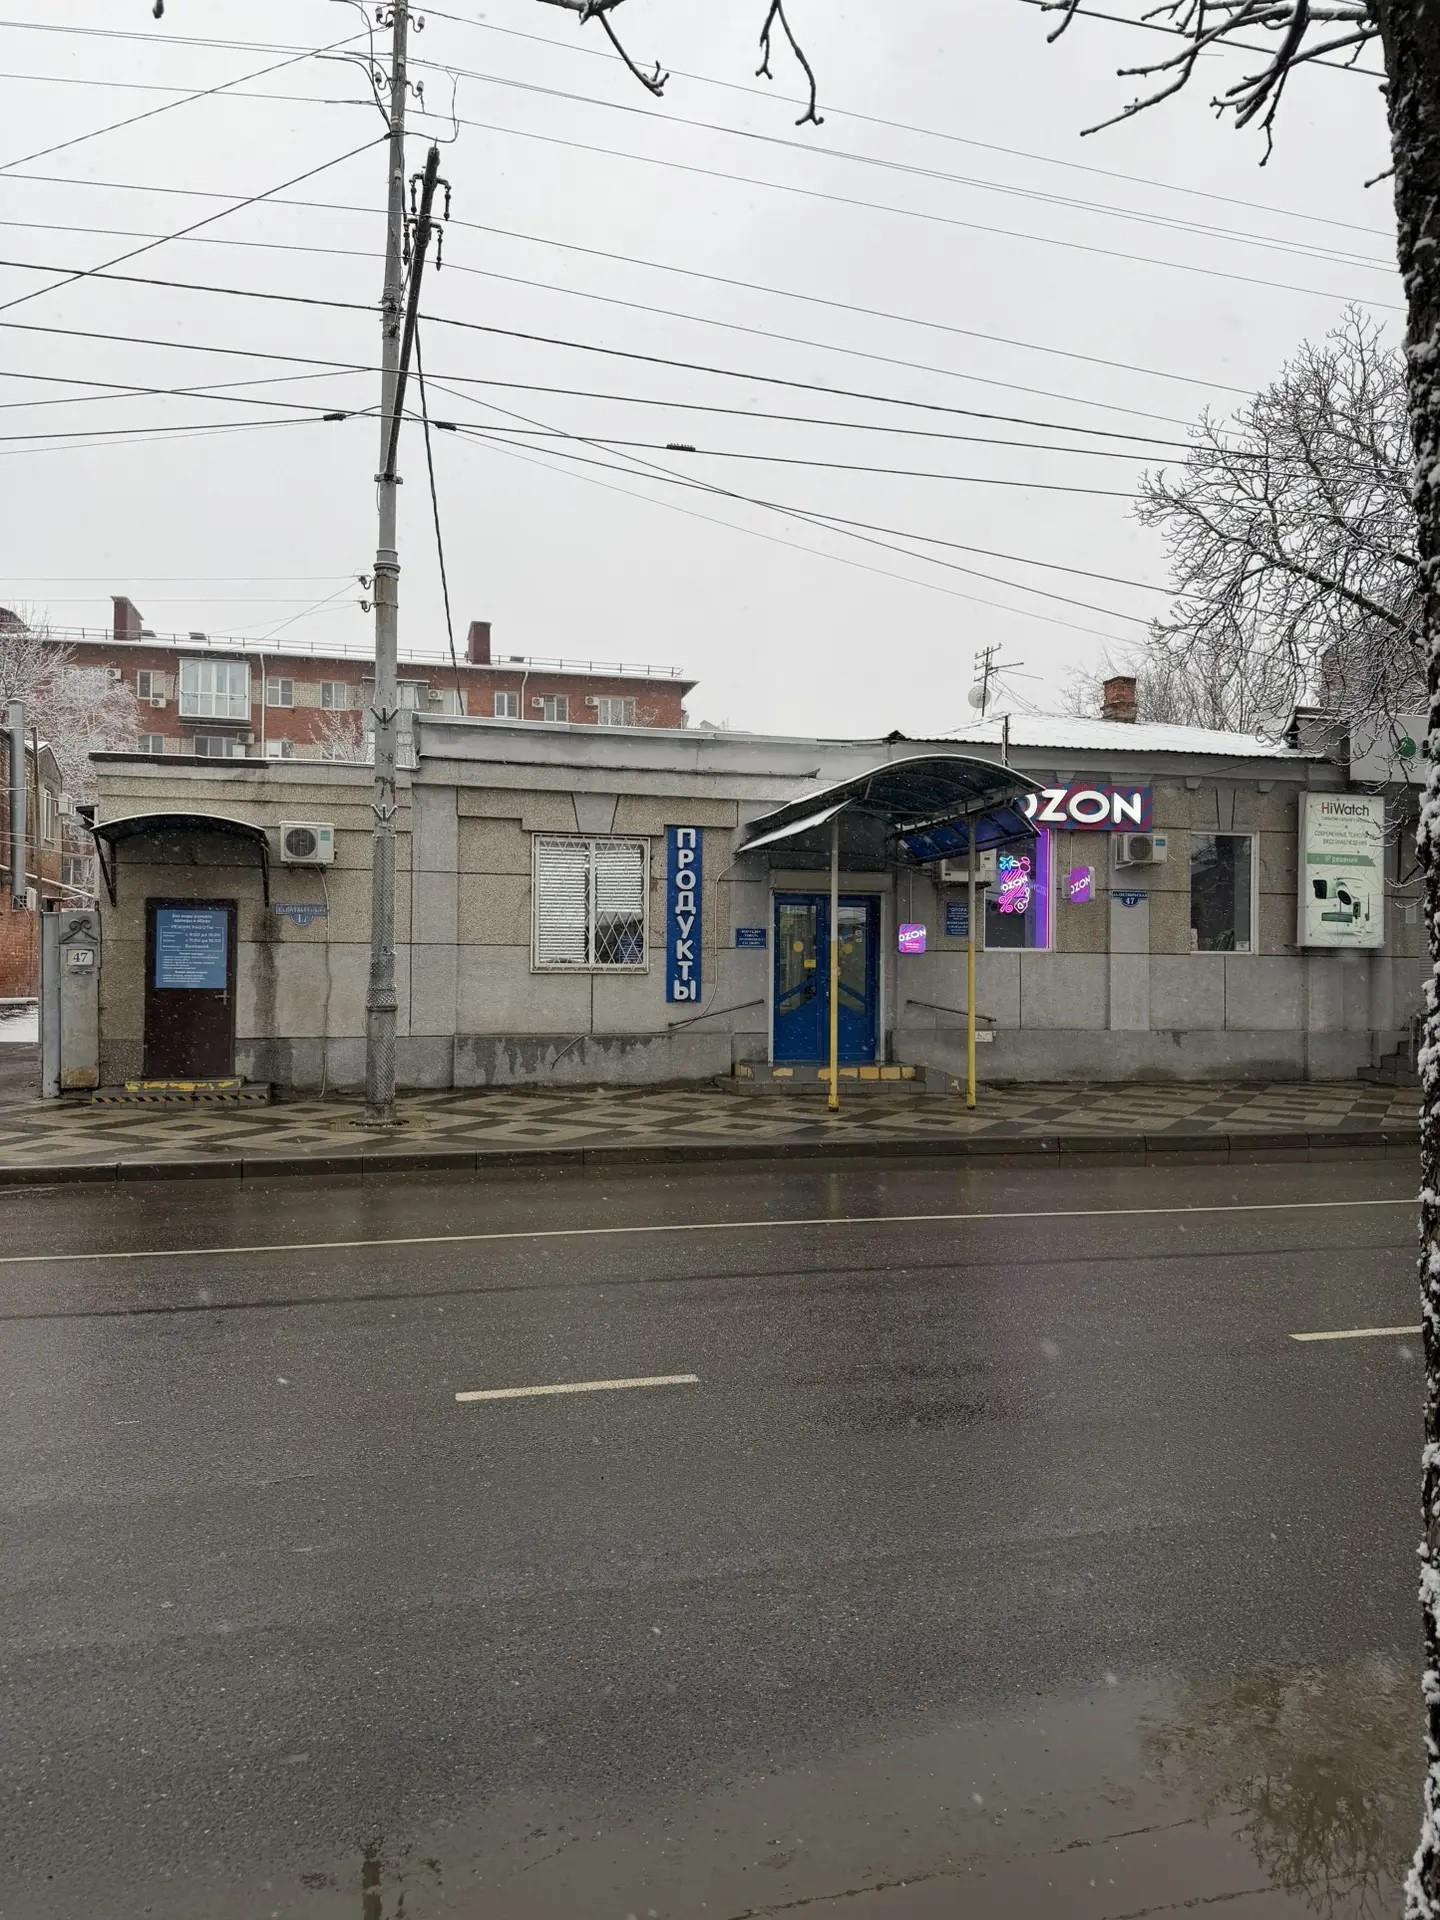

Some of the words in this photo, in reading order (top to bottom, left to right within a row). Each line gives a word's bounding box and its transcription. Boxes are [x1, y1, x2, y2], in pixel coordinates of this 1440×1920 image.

[1321, 802, 1370, 816] HiWatch
[1001, 876, 1029, 893] OZON
[673, 828, 697, 1001] ПРОДУКТЫ
[899, 928, 926, 942] OZON
[73, 952, 89, 963] 47
